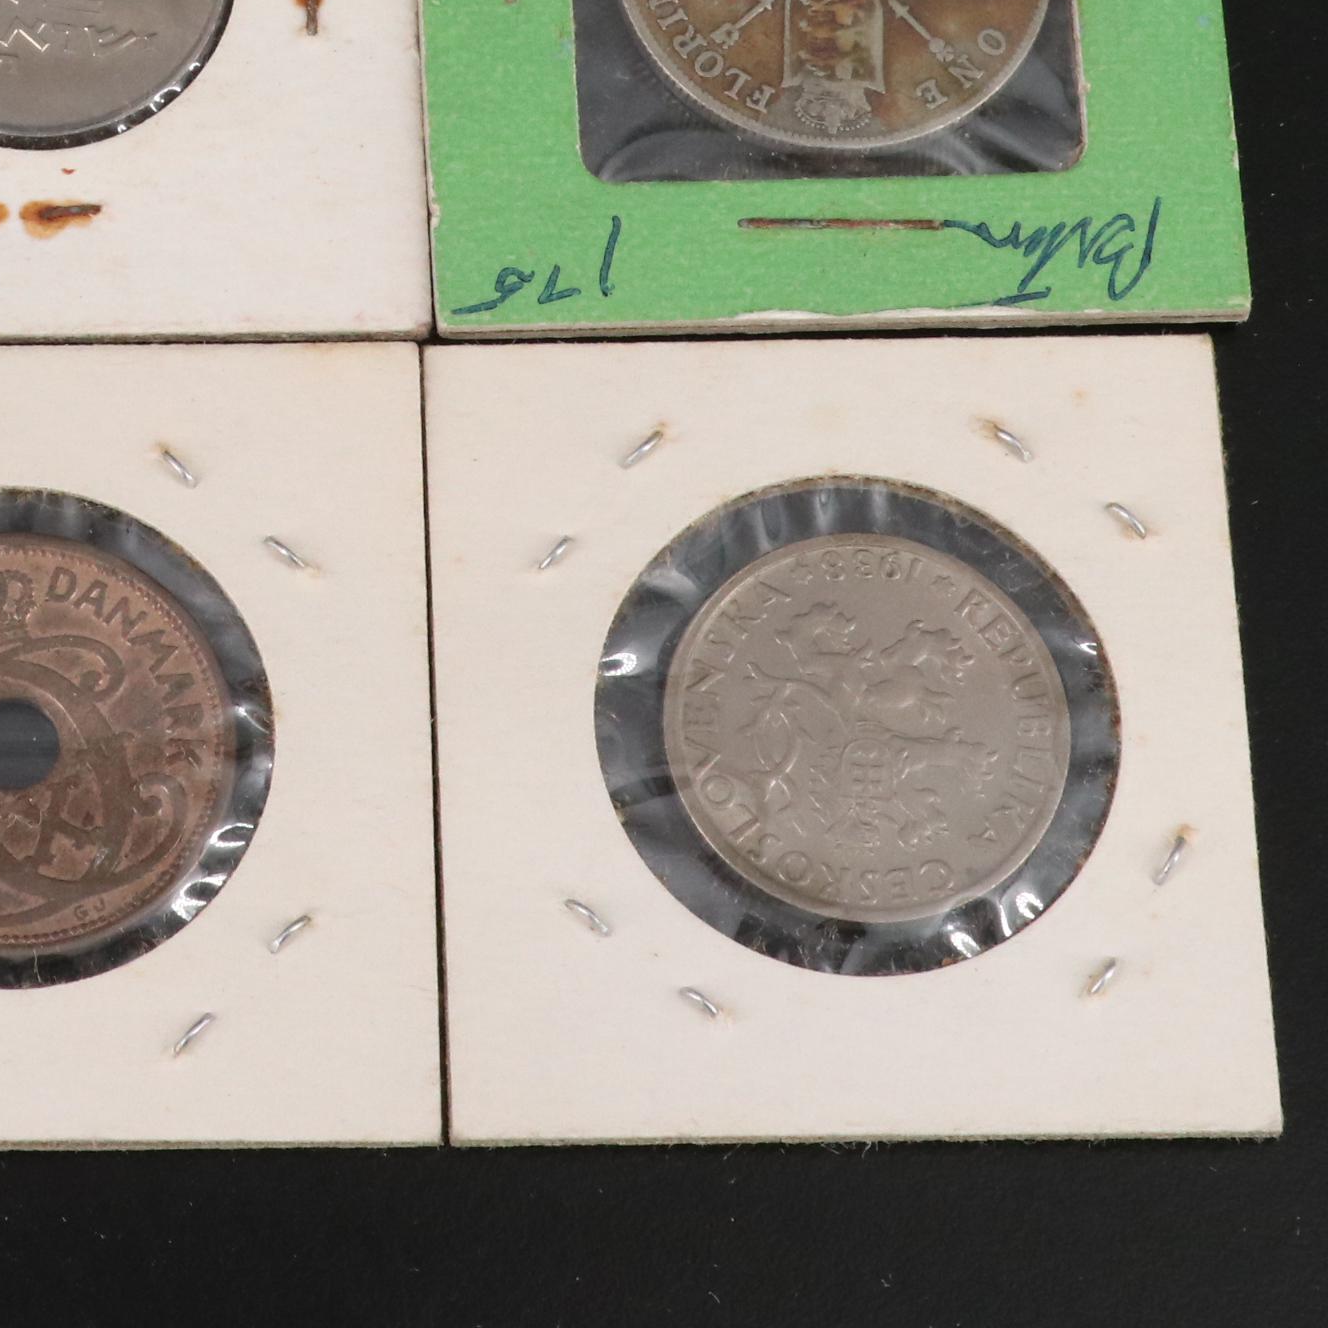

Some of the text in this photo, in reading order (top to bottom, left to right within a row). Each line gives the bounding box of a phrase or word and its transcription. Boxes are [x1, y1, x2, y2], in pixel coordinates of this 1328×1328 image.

[914, 28, 1008, 111] ONE
[44, 565, 209, 770] DANMARK
[953, 587, 1056, 844] REPUBLIKA
